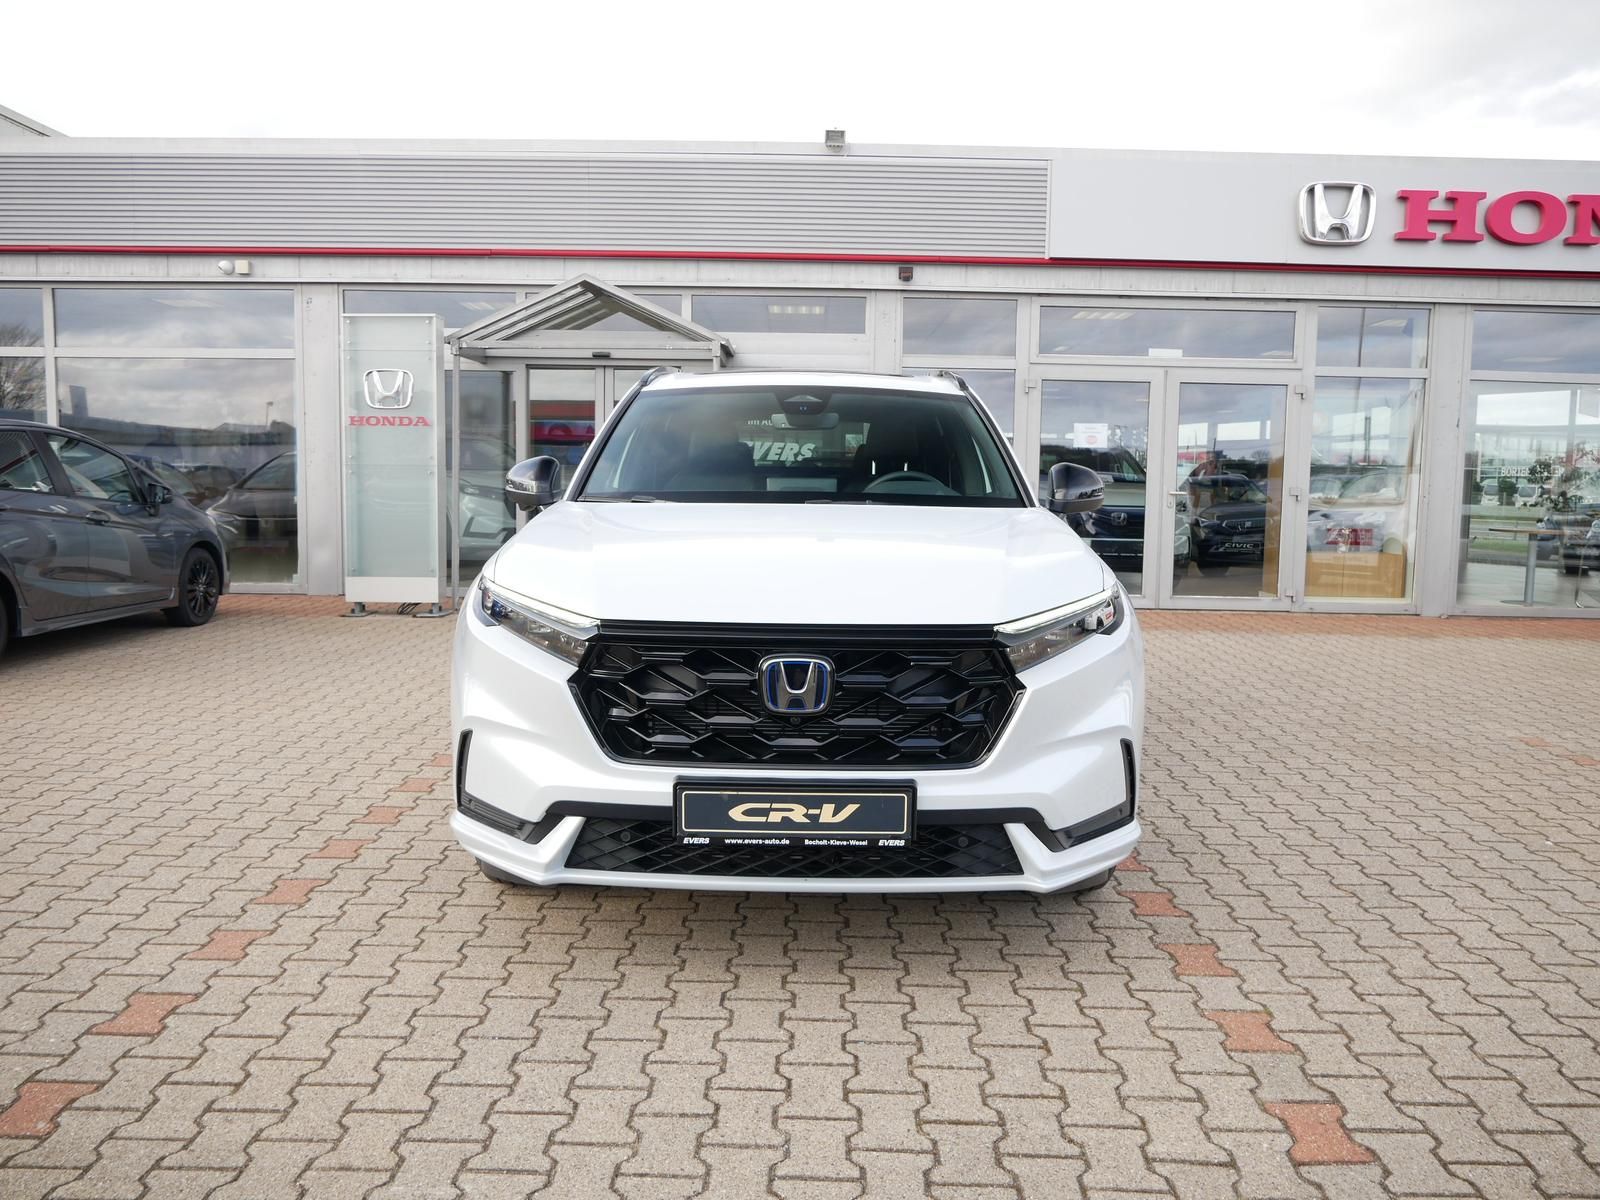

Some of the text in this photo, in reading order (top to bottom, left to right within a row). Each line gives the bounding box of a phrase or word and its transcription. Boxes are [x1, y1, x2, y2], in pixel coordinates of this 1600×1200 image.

[348, 415, 431, 427] HONDA
[742, 440, 817, 462] VERS
[728, 802, 861, 824] CR-V
[683, 837, 710, 845] EVERS
[878, 839, 906, 847] EVERS
